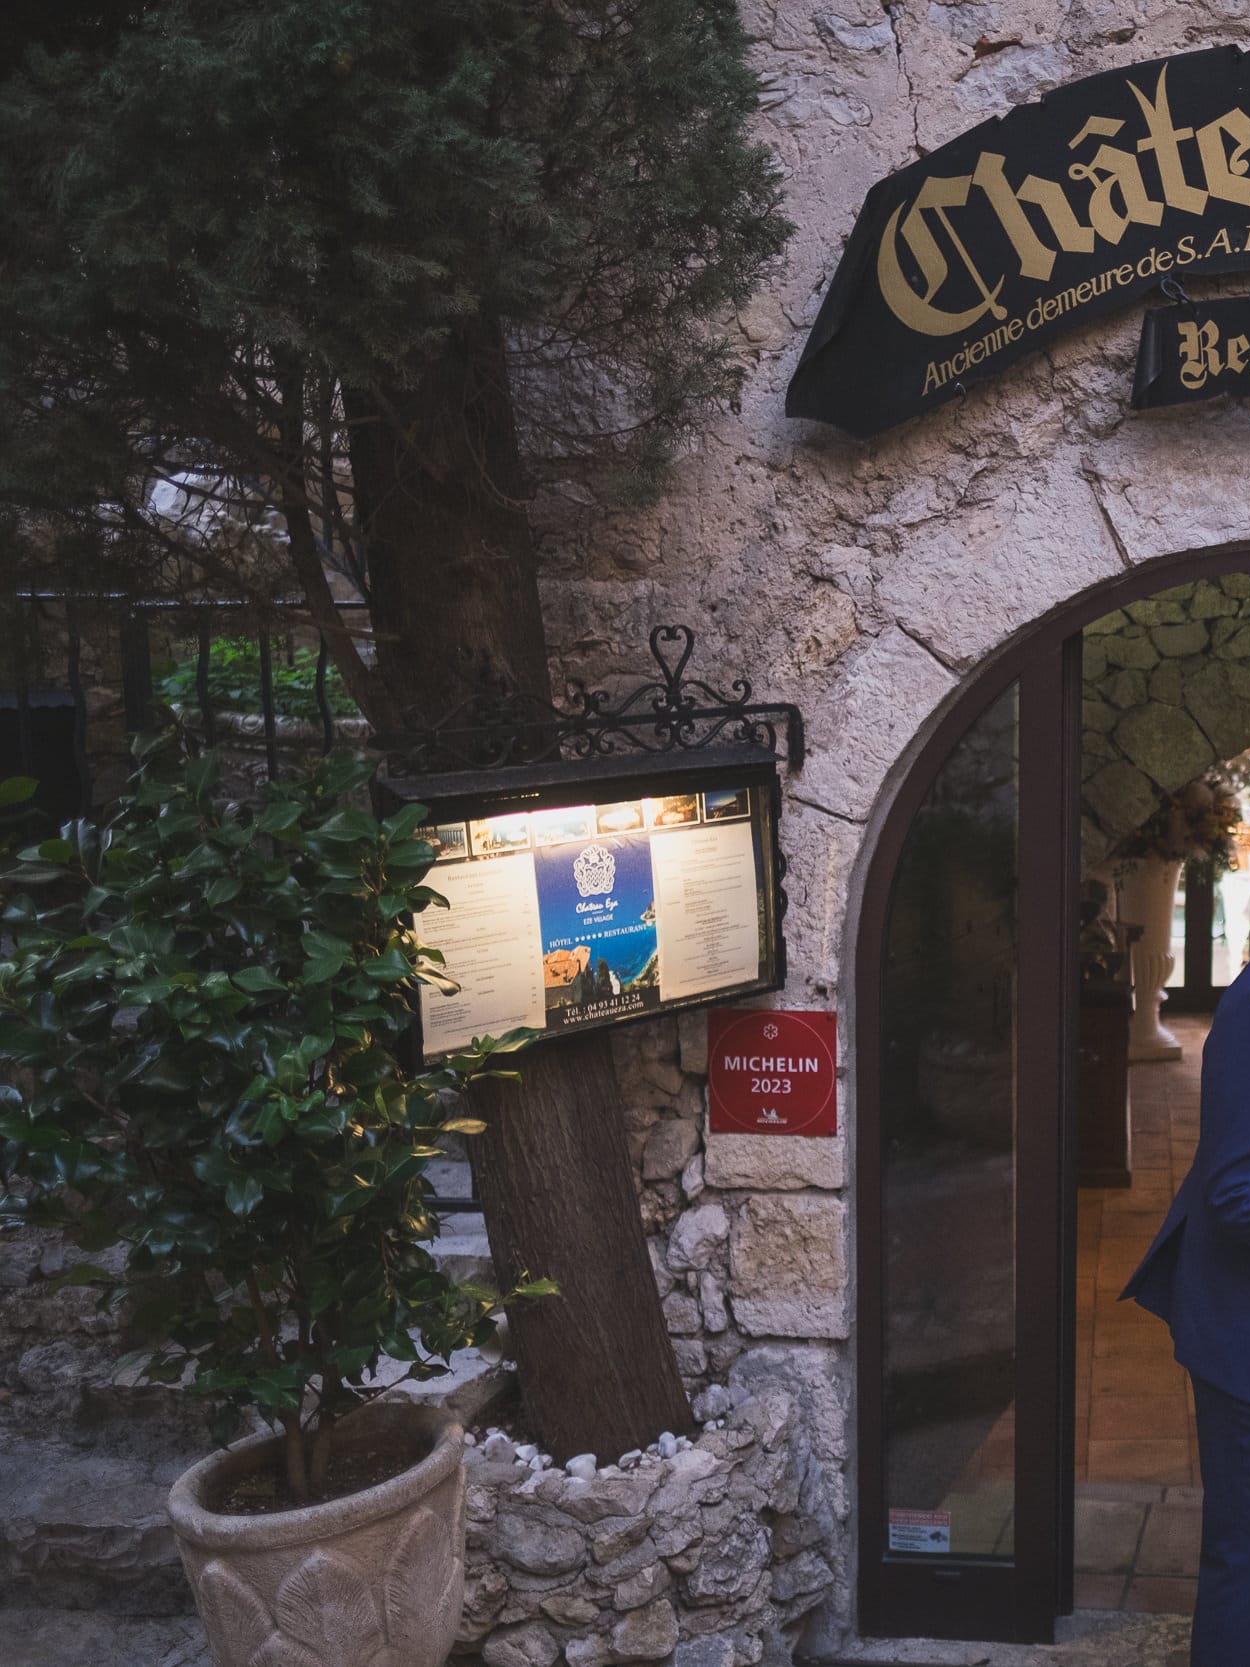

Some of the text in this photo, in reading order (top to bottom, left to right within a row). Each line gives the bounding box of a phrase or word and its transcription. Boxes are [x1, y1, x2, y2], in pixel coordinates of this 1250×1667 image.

[921, 317, 1024, 396] Ancienne
[1026, 263, 1135, 330] demeure
[1137, 247, 1175, 277] de
[549, 924, 647, 948] HÔTEL RESTAURANT
[563, 1001, 644, 1025] www.chateaueza.com
[587, 1003, 597, 1012] 04
[599, 1000, 608, 1010] 93
[609, 998, 618, 1007] 41
[621, 995, 630, 1005] 12
[631, 993, 640, 1003] 24
[724, 1055, 818, 1073] MICHELIN
[751, 1078, 792, 1094] 2023
